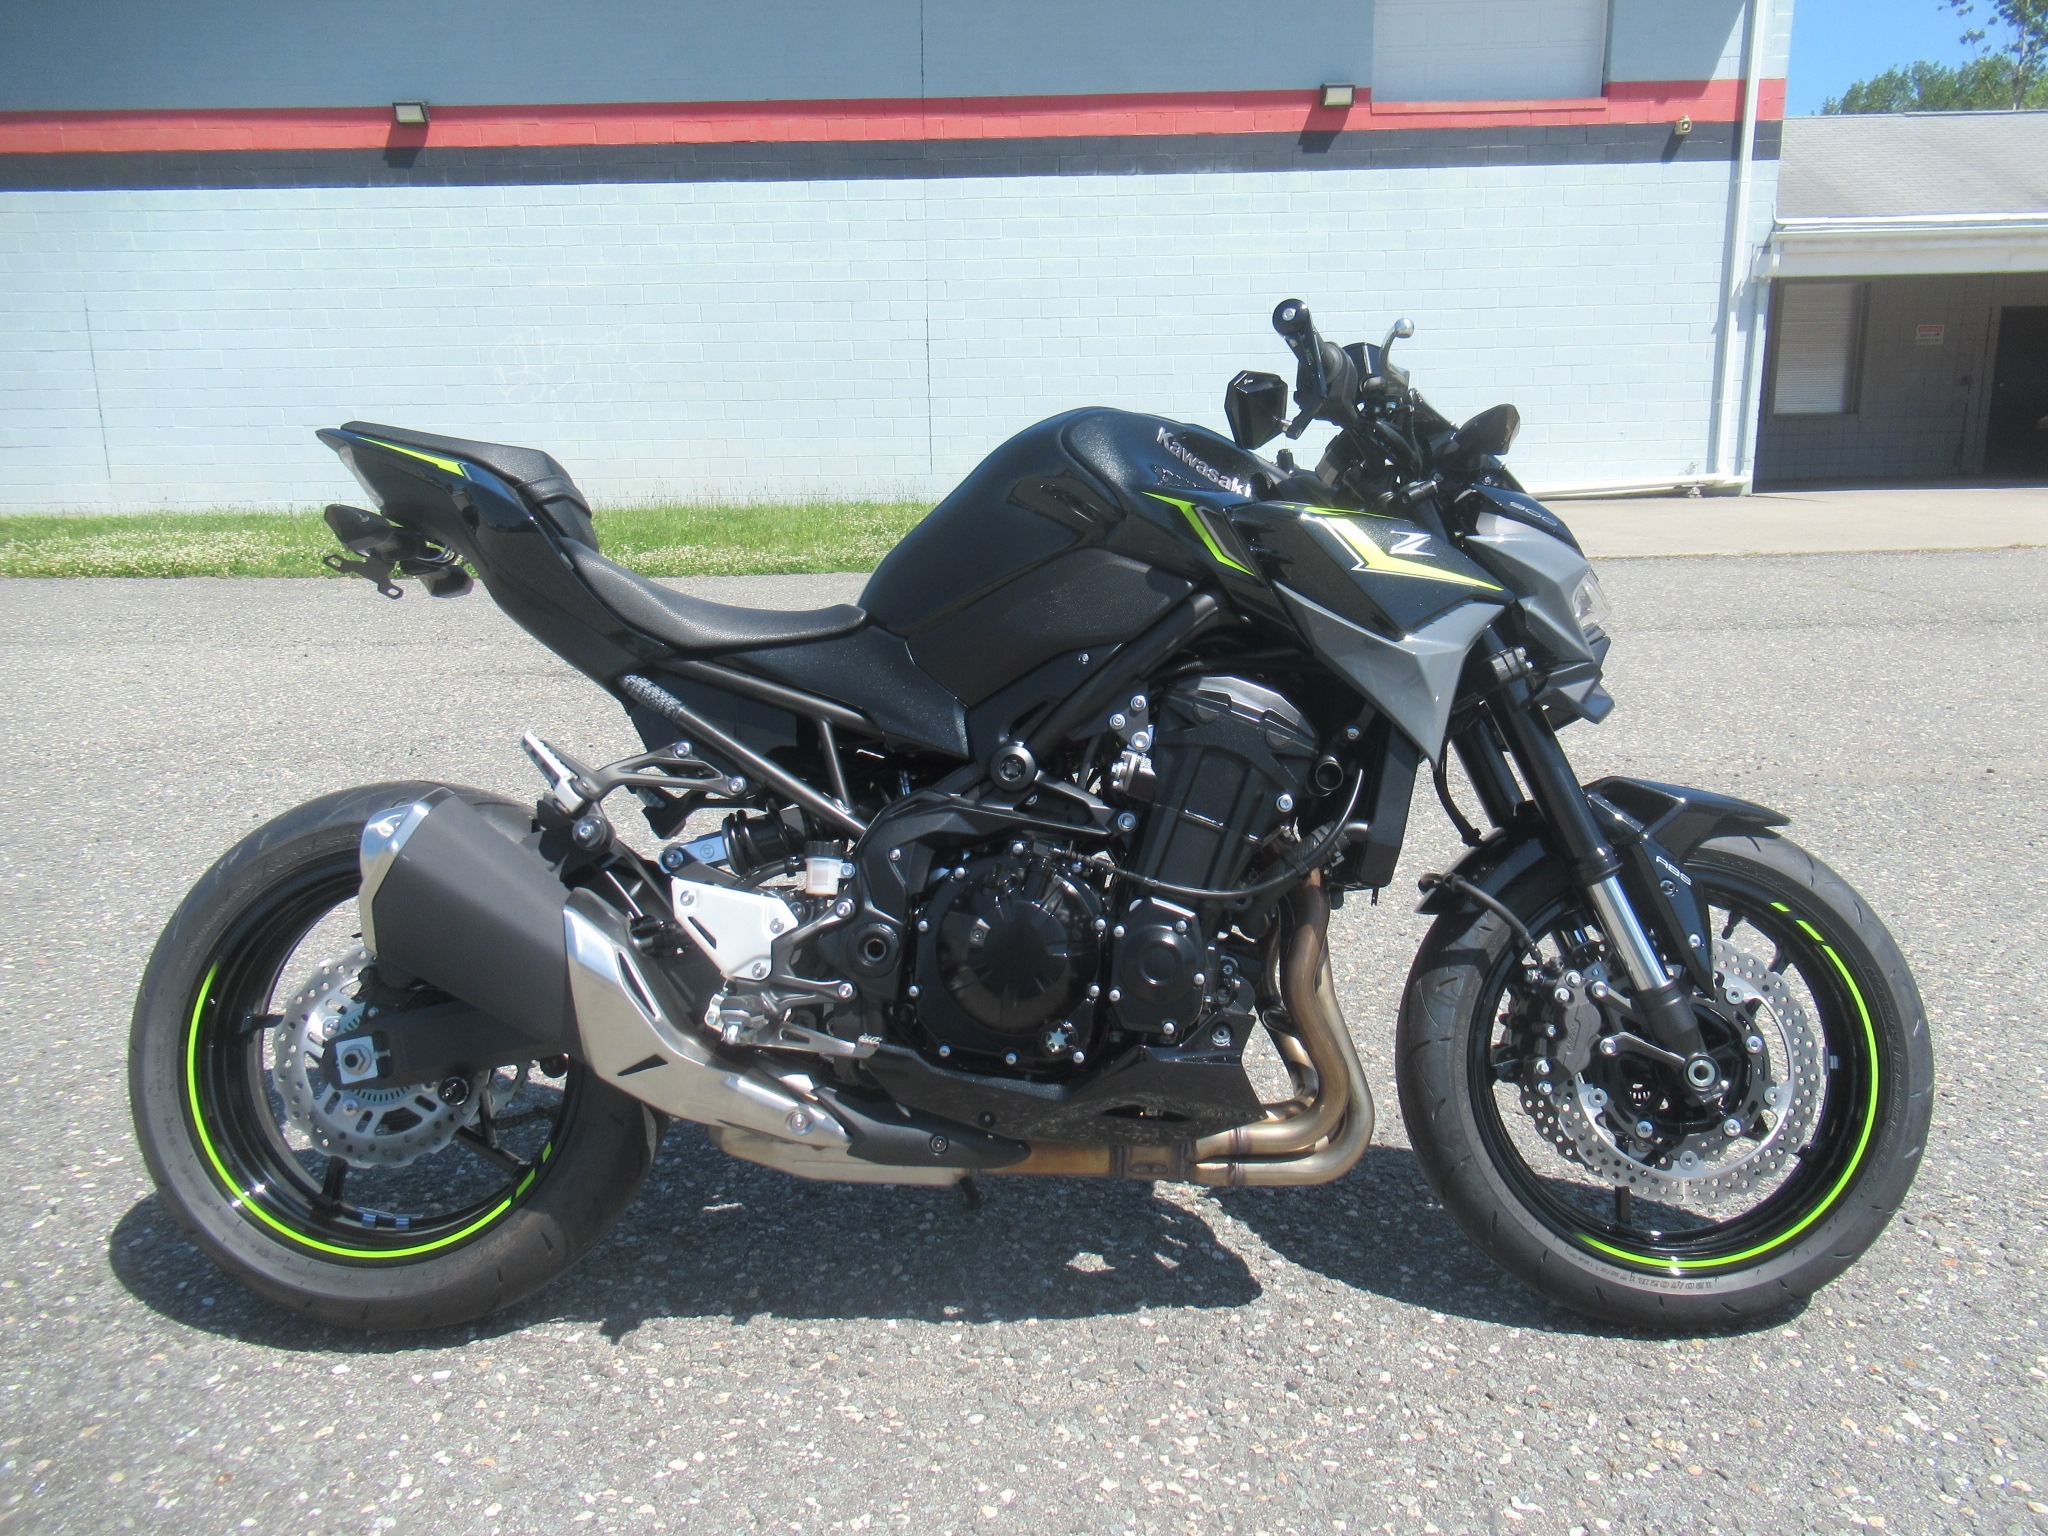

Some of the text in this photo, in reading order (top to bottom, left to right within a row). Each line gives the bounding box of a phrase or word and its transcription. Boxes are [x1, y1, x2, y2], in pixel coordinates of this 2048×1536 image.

[1156, 426, 1252, 498] Kawasaki
[1509, 501, 1557, 527] 900
[1389, 529, 1437, 557] Z
[1655, 855, 1692, 886] ABS
